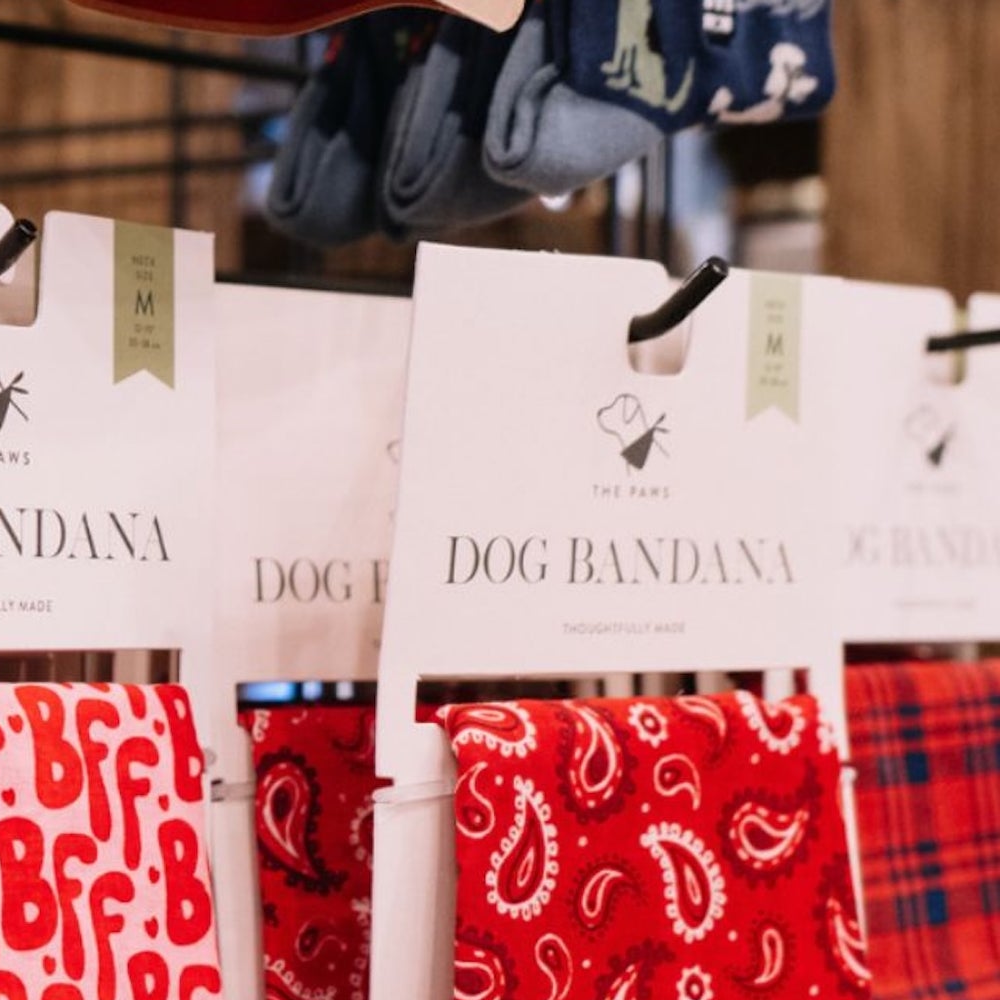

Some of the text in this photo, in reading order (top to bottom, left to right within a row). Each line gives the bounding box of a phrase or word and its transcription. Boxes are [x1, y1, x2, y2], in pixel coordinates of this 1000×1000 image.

[135, 290, 154, 316] M
[765, 332, 784, 356] M
[592, 484, 670, 499] THE PAWS
[445, 535, 547, 584] DOG
[568, 536, 796, 584] BANDANA
[253, 557, 353, 604] DOG
[18, 599, 53, 613] MADE
[562, 621, 650, 635] THOUGHTFULLY
[14, 685, 160, 870] BFF
